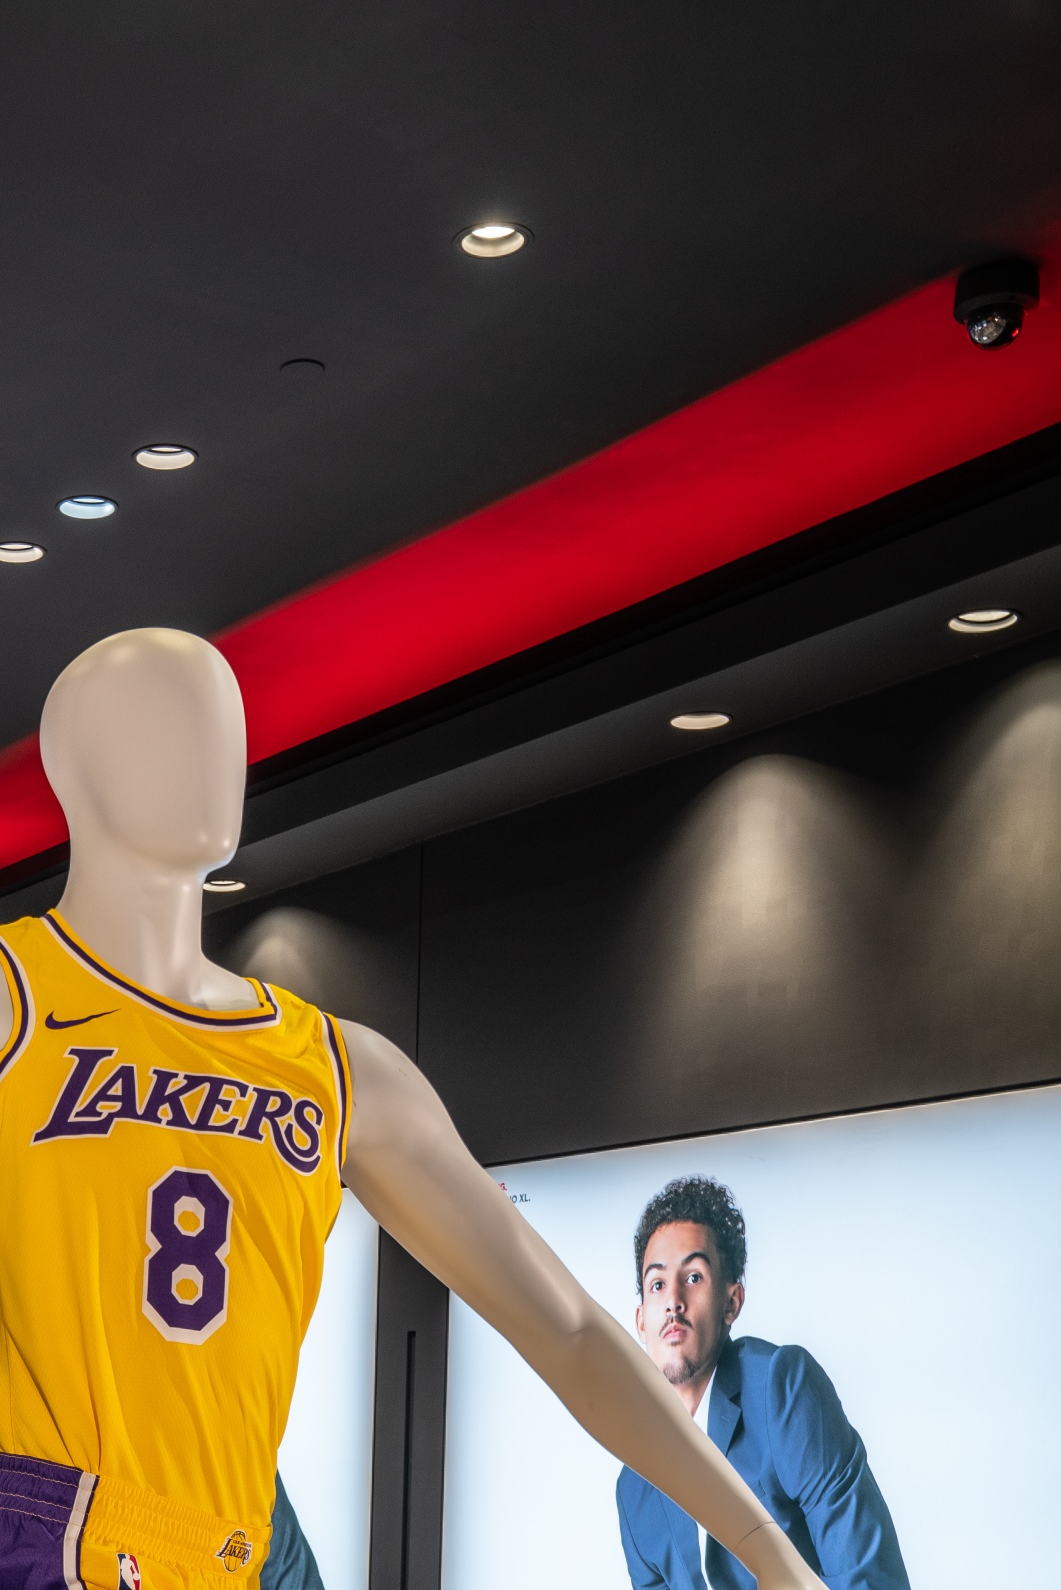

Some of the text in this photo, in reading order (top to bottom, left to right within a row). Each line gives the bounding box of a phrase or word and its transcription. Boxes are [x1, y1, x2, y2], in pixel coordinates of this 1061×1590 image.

[30, 1046, 325, 1177] LAKERS
[142, 1166, 234, 1346] 8
[215, 1537, 252, 1565] LAKERS
